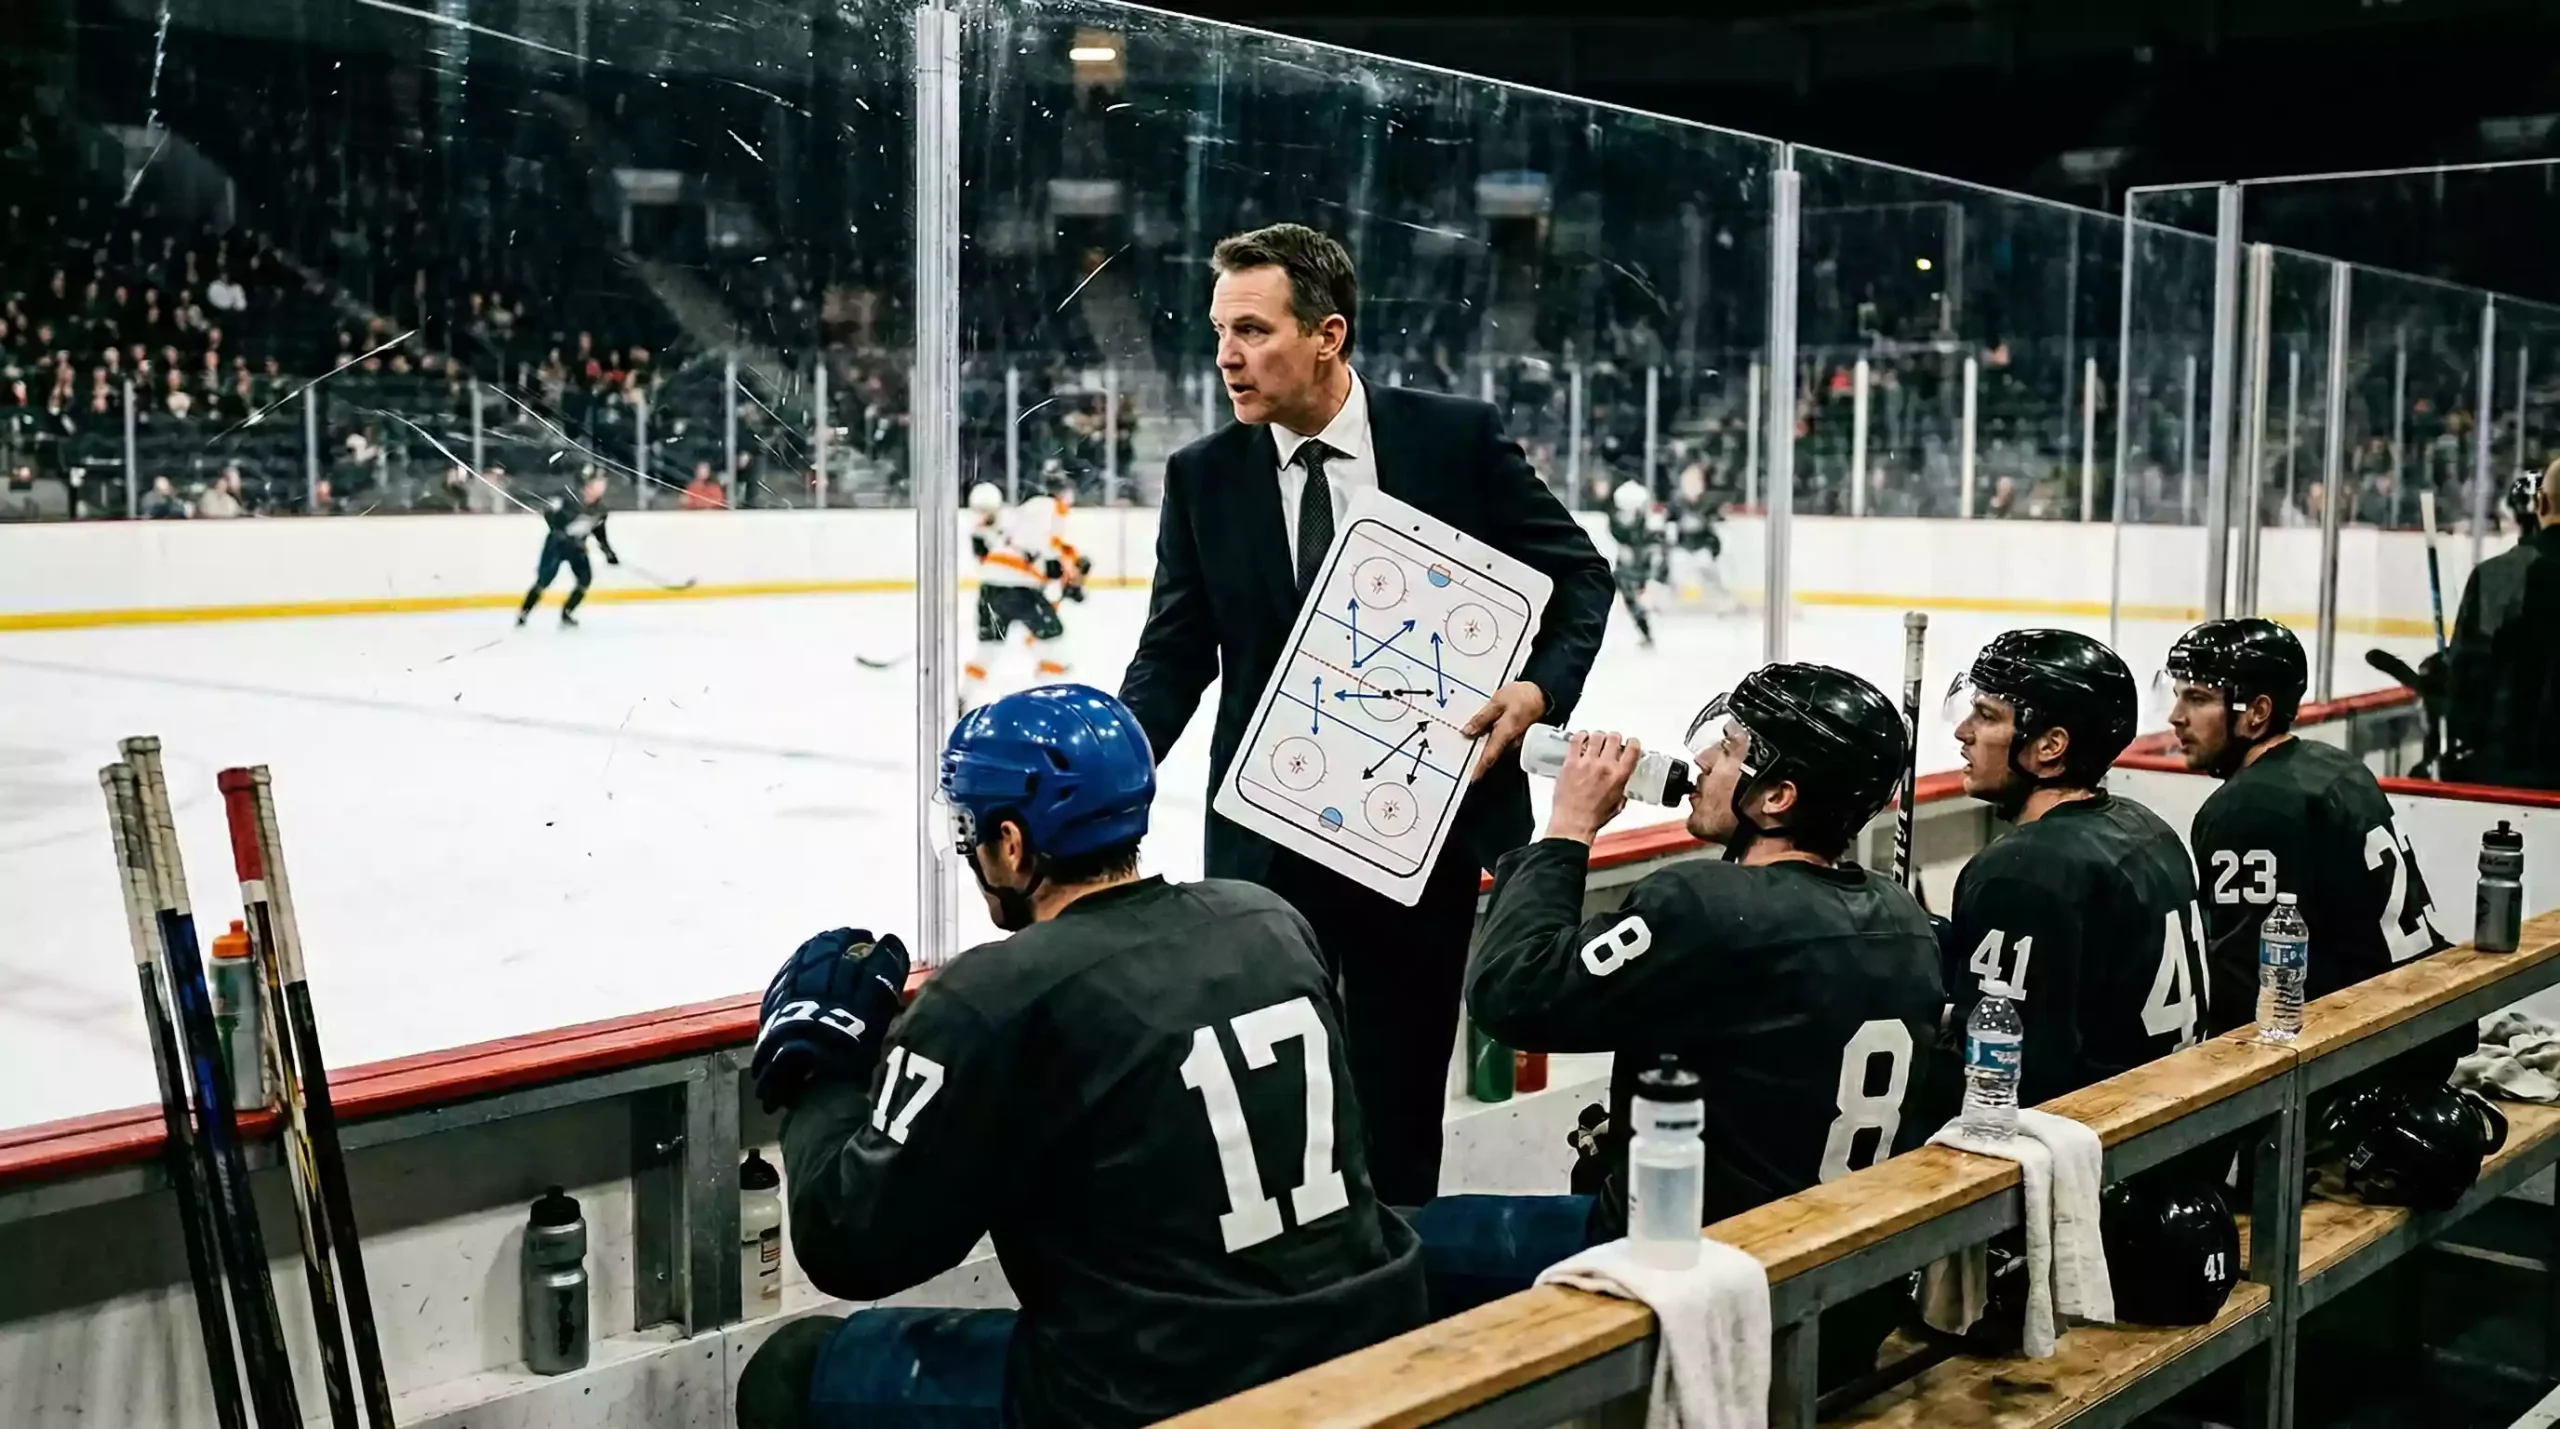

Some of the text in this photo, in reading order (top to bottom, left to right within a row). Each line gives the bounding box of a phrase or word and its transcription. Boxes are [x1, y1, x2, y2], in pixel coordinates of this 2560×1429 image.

[2211, 849, 2277, 904] 23
[1580, 915, 1652, 977] 8
[1969, 928, 2033, 1001] 41
[871, 1045, 945, 1144] 17
[1179, 995, 1351, 1254] 17
[1818, 1018, 1914, 1184] 8
[2203, 1252, 2226, 1282] 41
